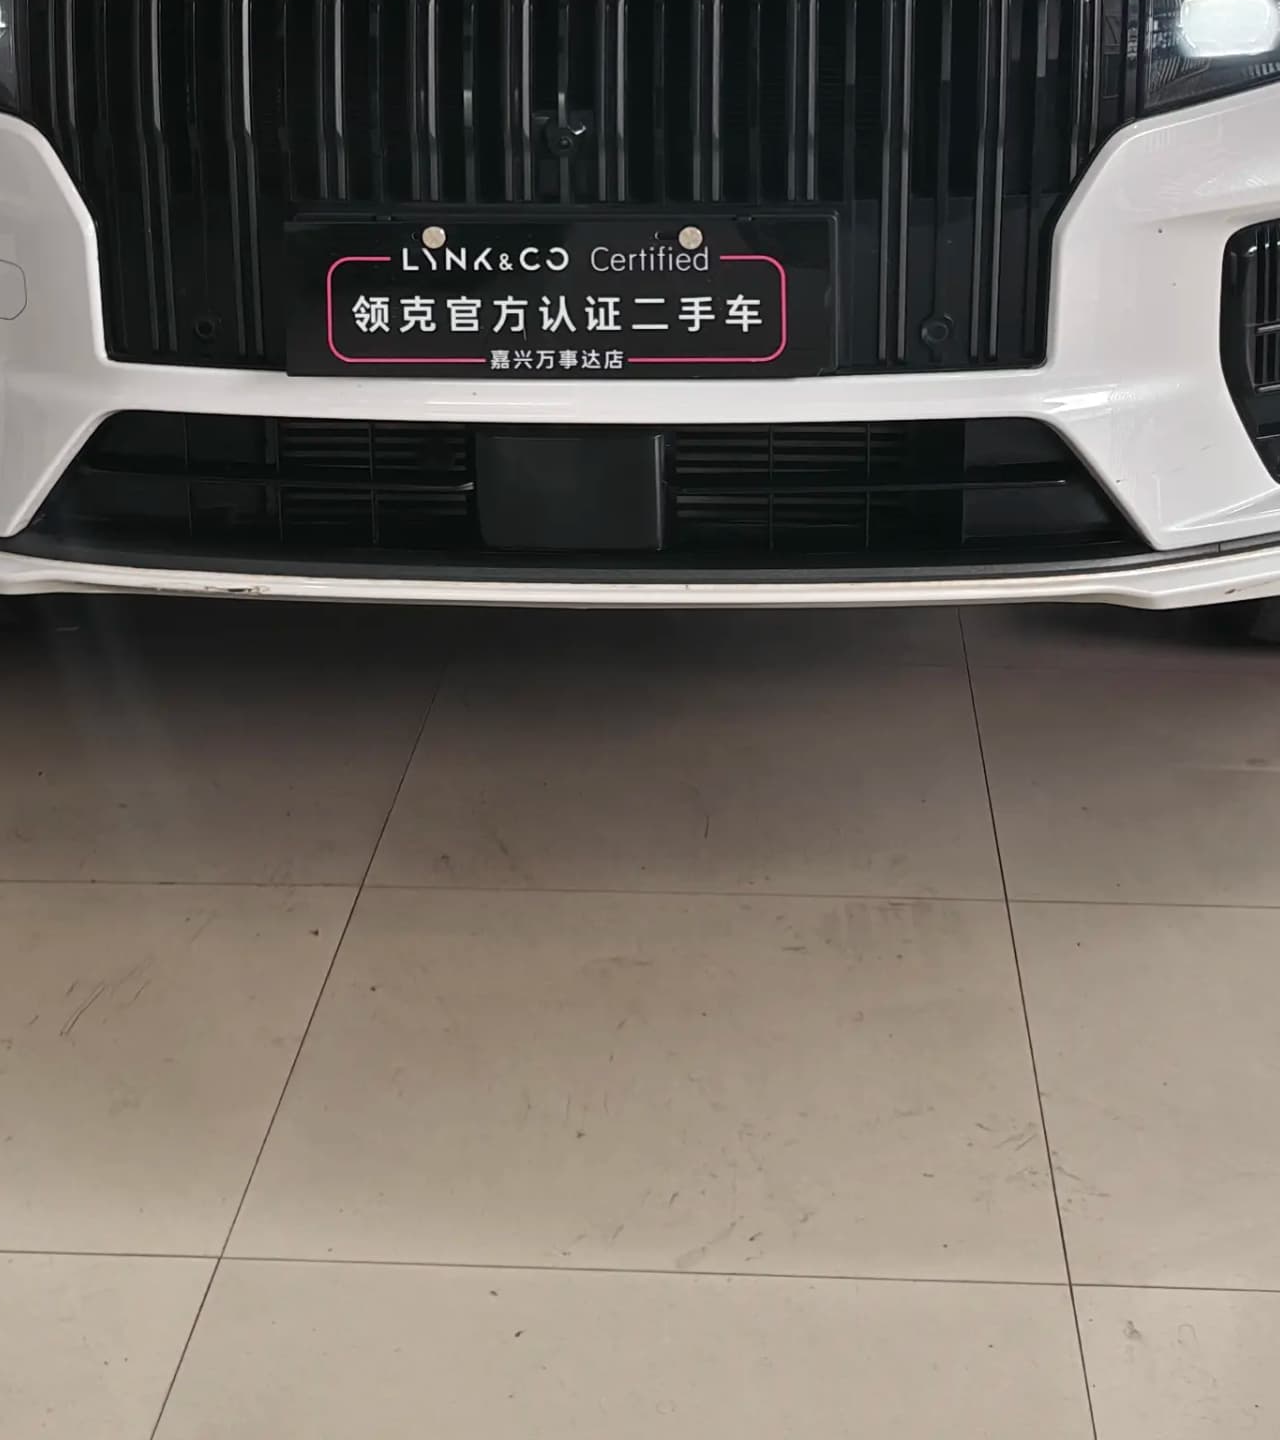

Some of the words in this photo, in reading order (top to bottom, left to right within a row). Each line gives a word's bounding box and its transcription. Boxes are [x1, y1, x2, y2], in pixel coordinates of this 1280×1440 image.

[590, 246, 709, 272] Certified
[351, 294, 764, 333] 领克官方认证二手车
[489, 348, 625, 370] 嘉兴万事达店
